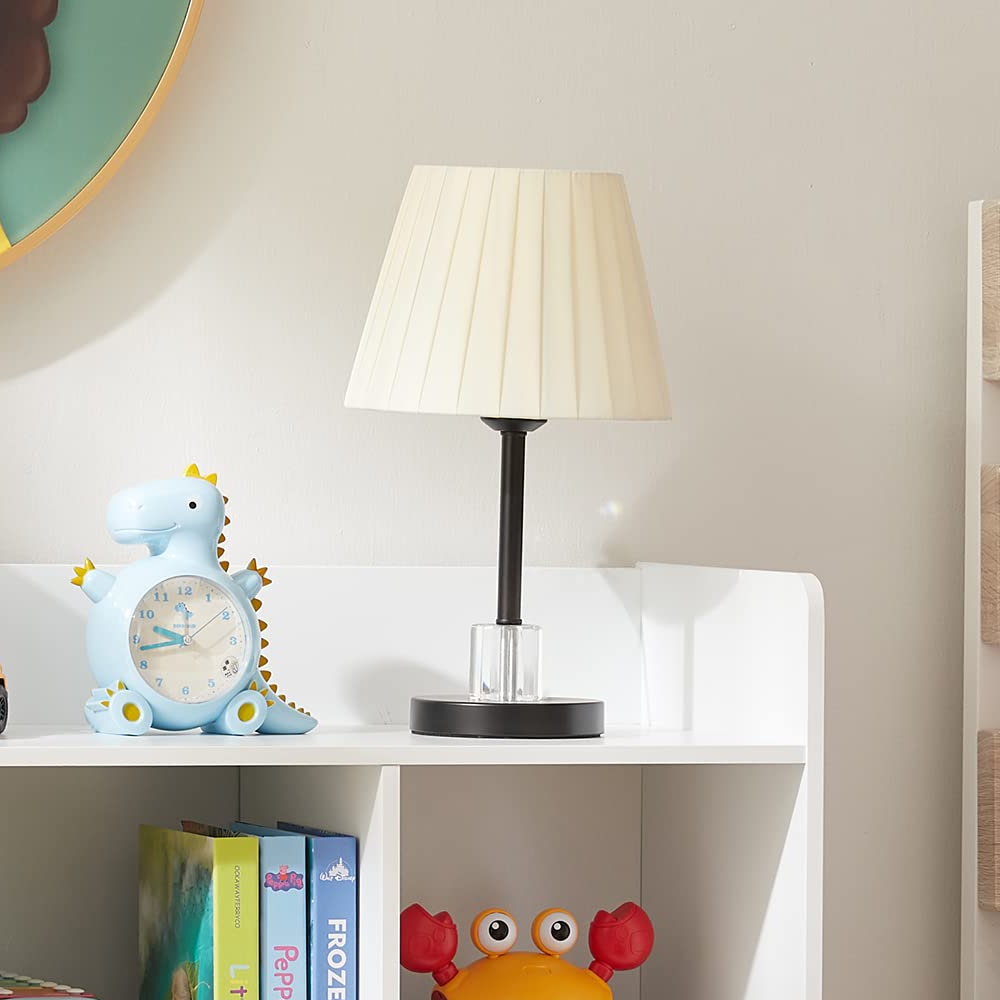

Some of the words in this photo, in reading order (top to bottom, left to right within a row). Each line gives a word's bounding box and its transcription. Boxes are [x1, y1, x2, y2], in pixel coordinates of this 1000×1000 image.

[178, 586, 192, 596] 12
[154, 592, 169, 602] 11
[205, 593, 211, 602] 1
[140, 609, 155, 620] 10
[222, 611, 230, 621] 2
[230, 636, 238, 646] 3
[140, 660, 148, 670] 8
[156, 678, 163, 688] 7
[208, 678, 216, 688] 5
[182, 686, 190, 696] 6
